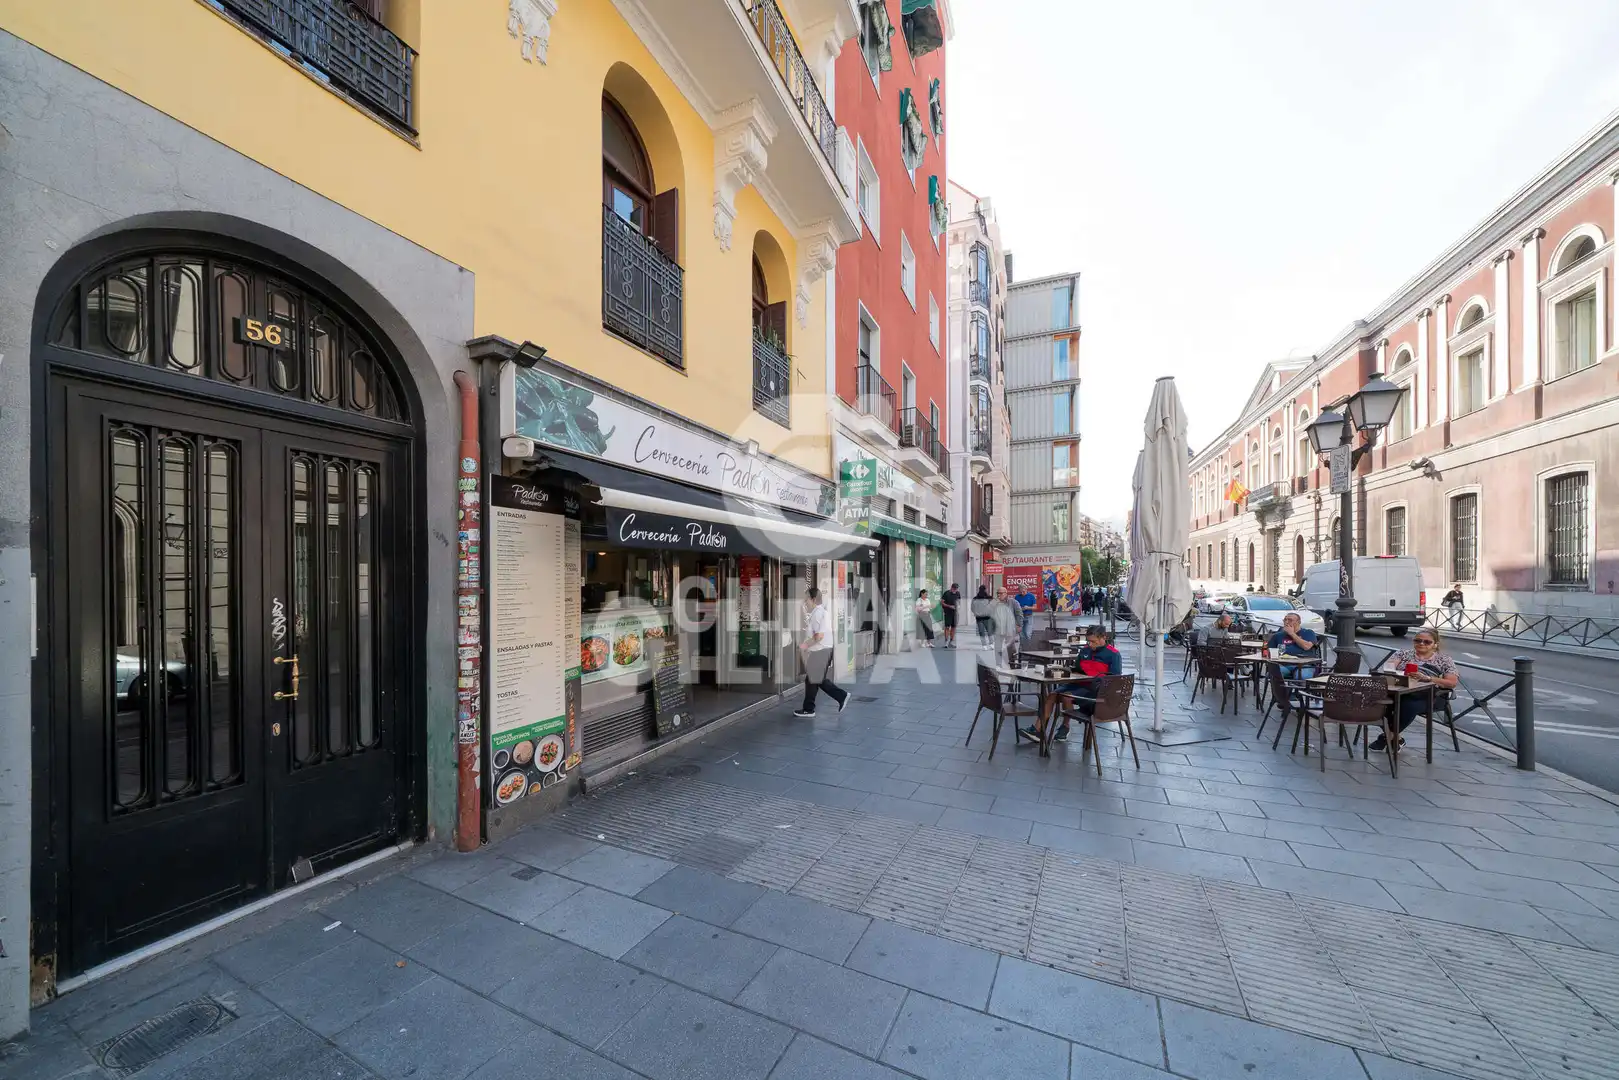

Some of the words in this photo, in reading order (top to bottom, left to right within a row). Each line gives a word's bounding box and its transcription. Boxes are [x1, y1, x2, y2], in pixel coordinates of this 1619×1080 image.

[246, 319, 282, 346] 56
[634, 425, 710, 476] Cervecería
[717, 452, 770, 495] Padrón
[511, 484, 549, 502] Padrón
[497, 511, 527, 520] ENTRADAS
[844, 507, 869, 519] ATM
[620, 513, 681, 543] Cervecería
[686, 522, 727, 548] Padrón
[1002, 555, 1053, 565] RESTAURANTE
[1007, 577, 1038, 586] ENORME
[497, 643, 530, 654] ENSALADAS
[534, 641, 554, 649] PASTAS
[497, 689, 519, 699] TOSTAS
